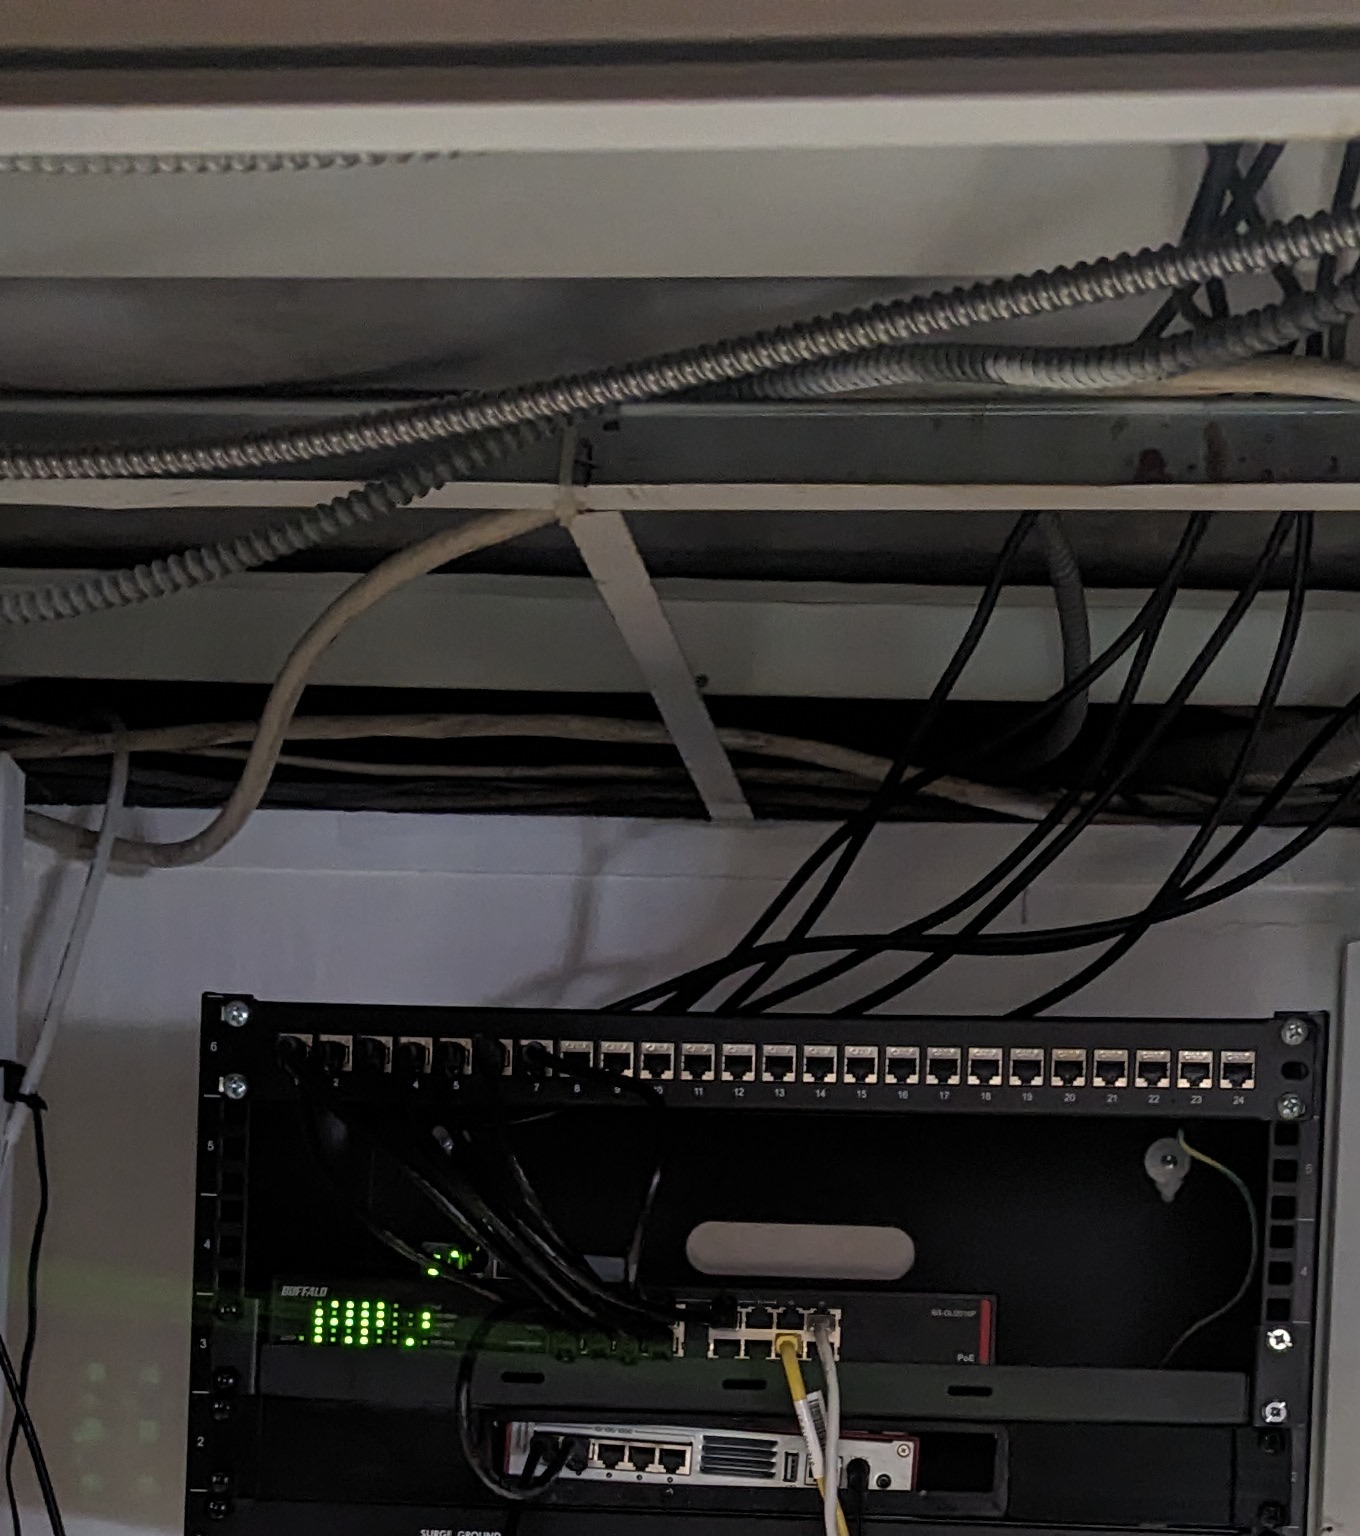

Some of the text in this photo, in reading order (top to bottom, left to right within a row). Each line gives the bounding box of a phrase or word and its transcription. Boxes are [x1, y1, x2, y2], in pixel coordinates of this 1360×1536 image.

[209, 1041, 218, 1052] 6
[412, 1079, 420, 1090] 4
[533, 1082, 540, 1092] 7
[573, 1083, 581, 1093] 8
[694, 1087, 704, 1096] 11
[734, 1087, 745, 1097] 12
[774, 1088, 785, 1098] 13
[815, 1089, 826, 1098] 14
[856, 1089, 868, 1098] 15
[939, 1091, 950, 1100] 17
[1064, 1093, 1076, 1102] 20
[1106, 1094, 1118, 1103] 21
[1148, 1094, 1160, 1104] 22
[1191, 1095, 1202, 1104] 23
[1233, 1095, 1245, 1105] 24
[202, 1238, 211, 1250] 4
[280, 1285, 328, 1298] BUFFALO
[199, 1338, 208, 1349] 3
[197, 1435, 205, 1447] 2
